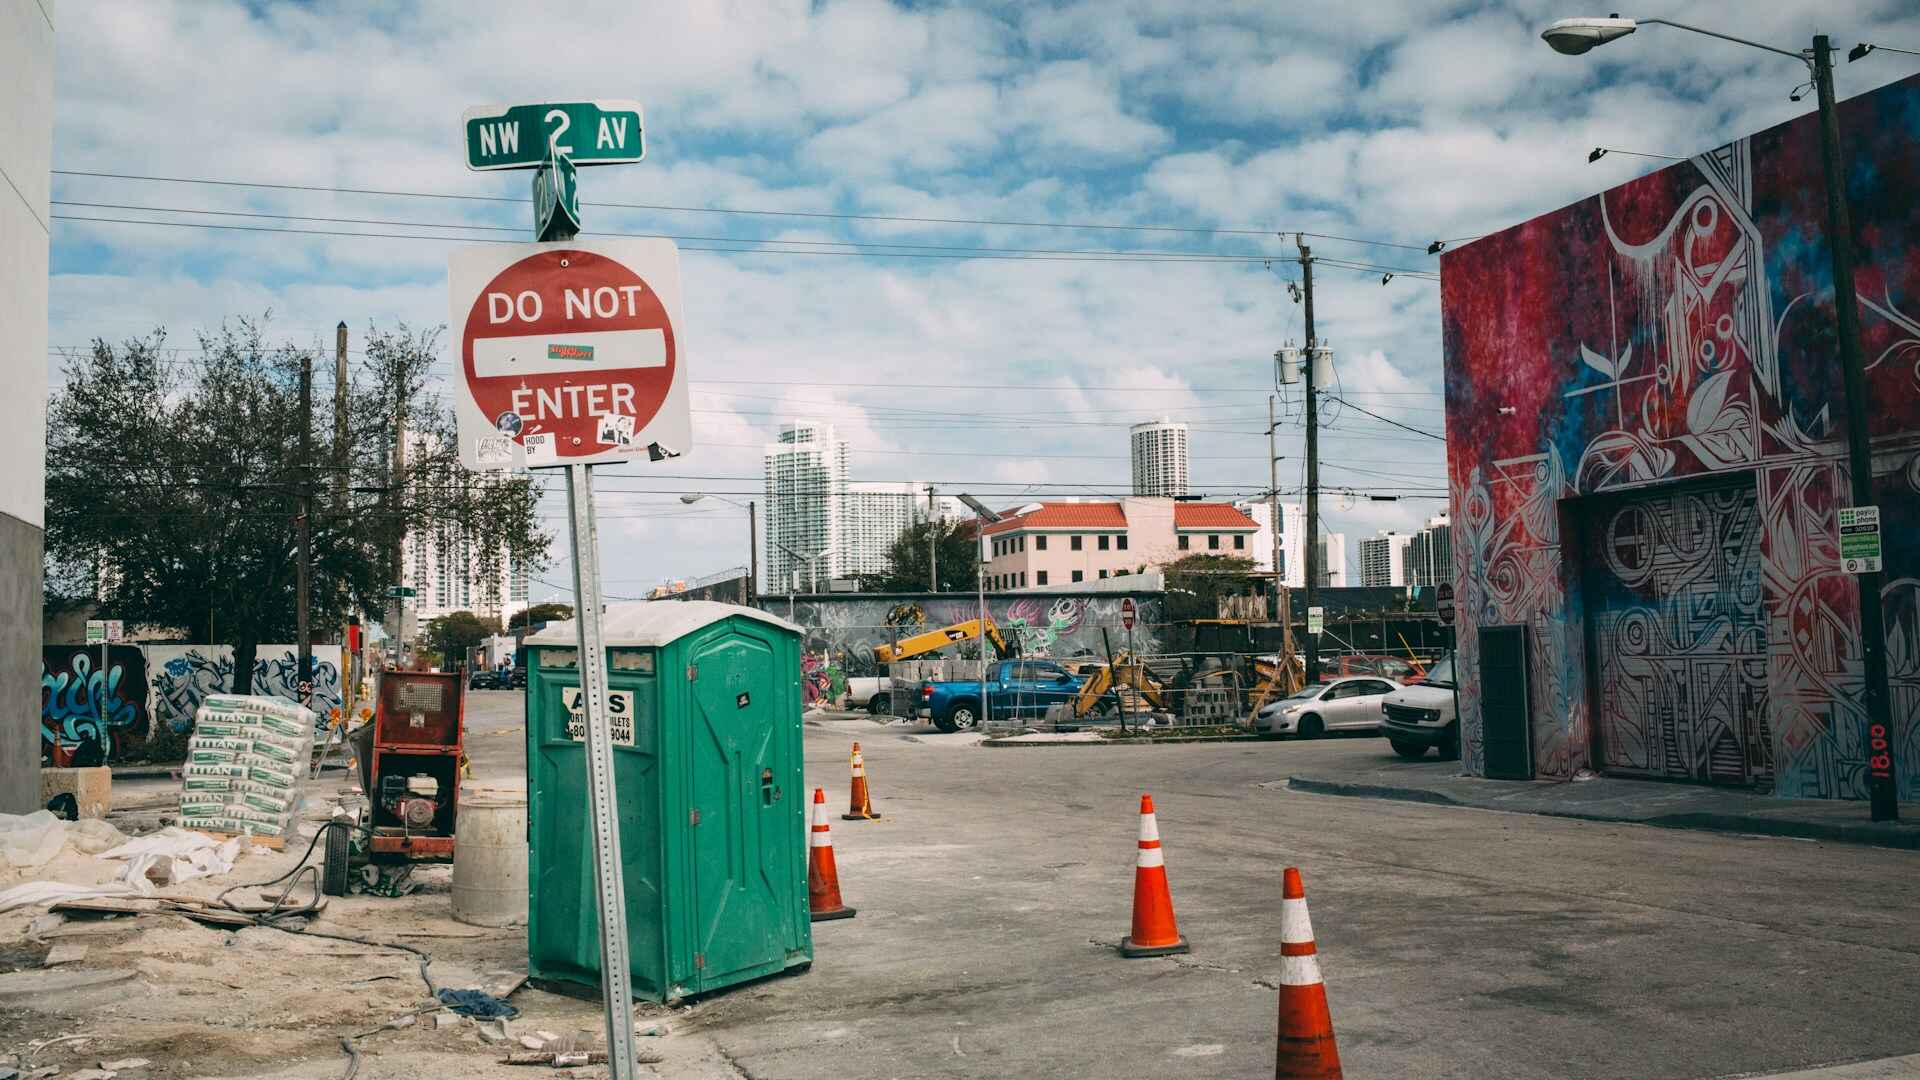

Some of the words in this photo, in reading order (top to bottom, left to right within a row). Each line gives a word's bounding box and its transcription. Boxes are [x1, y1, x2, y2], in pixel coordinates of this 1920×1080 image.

[479, 121, 519, 157] NW
[544, 109, 573, 154] 2
[596, 117, 628, 150] AV
[487, 290, 543, 324] DO
[564, 285, 642, 320] NOT
[511, 383, 638, 422] ENTER
[527, 446, 536, 455] BY
[204, 713, 247, 723] TITAN
[194, 740, 238, 750] TITAN
[188, 766, 231, 776] TITAN
[182, 818, 225, 828] TITAN
